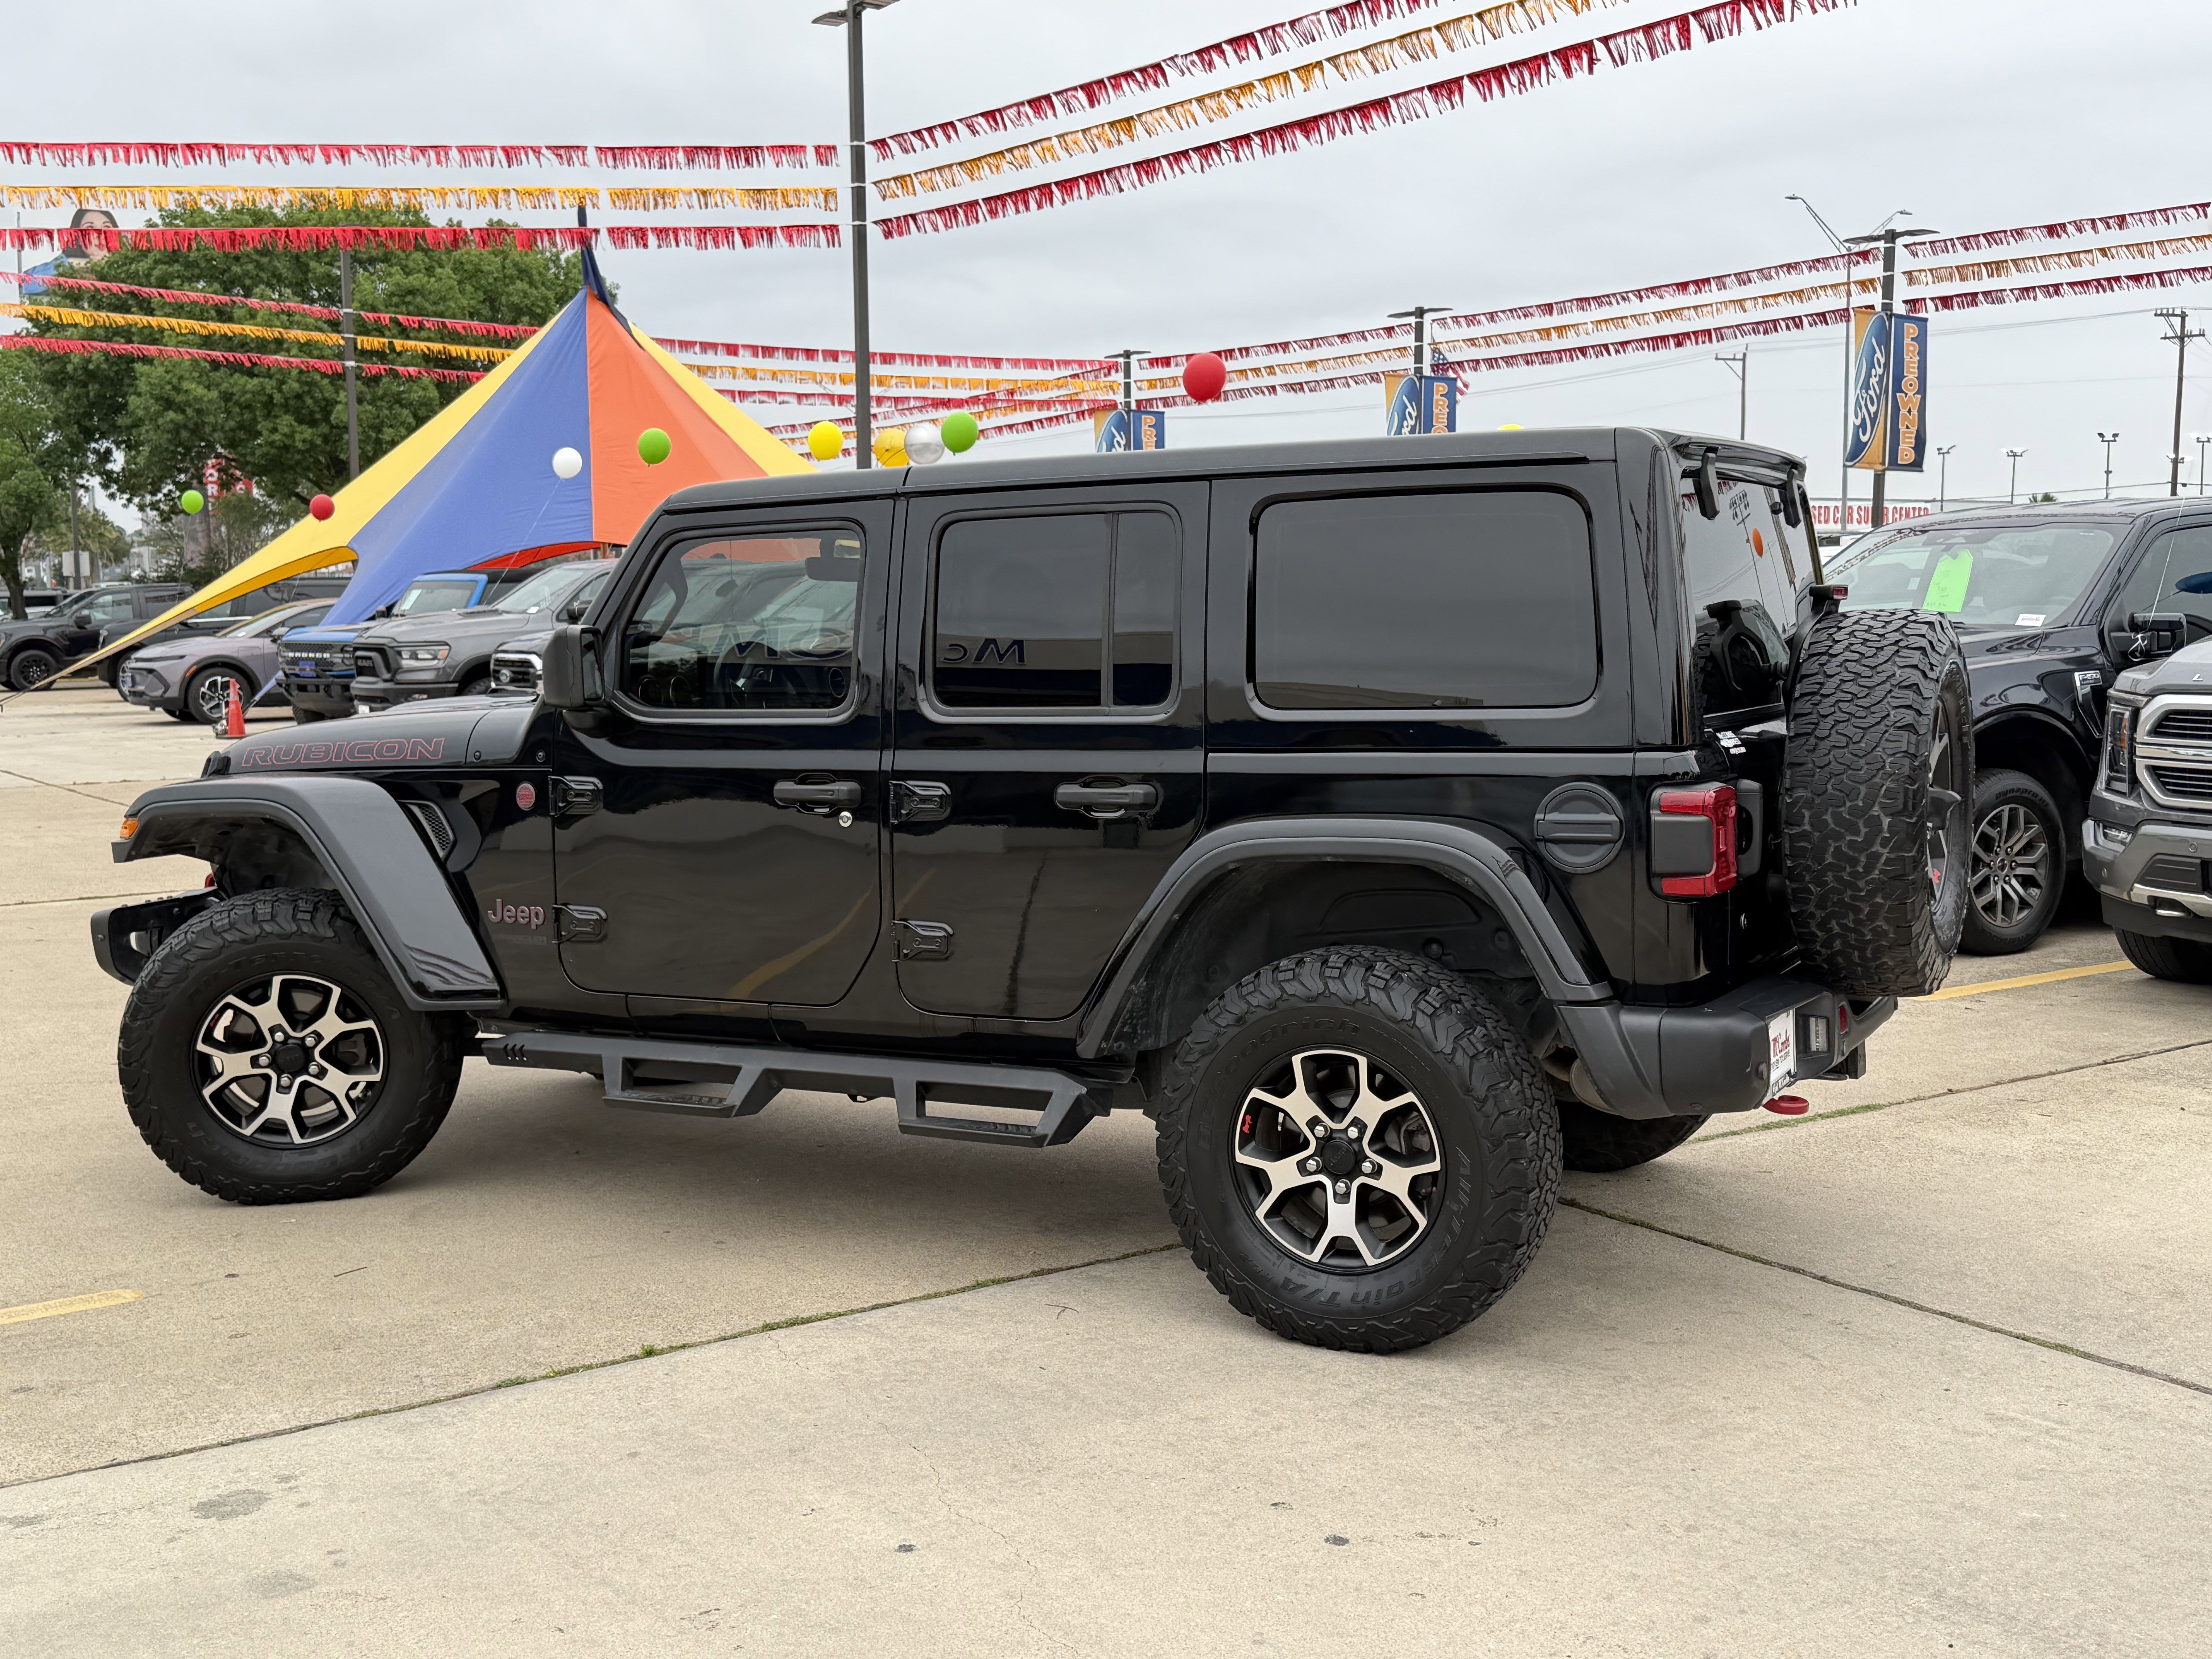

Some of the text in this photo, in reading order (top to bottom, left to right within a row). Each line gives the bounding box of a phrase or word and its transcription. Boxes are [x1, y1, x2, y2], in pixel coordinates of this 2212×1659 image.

[1853, 336, 1885, 442] Ford
[1896, 323, 1921, 464] PREOWNED
[1812, 505, 1831, 524] SED
[1833, 505, 1854, 525] CR
[1856, 506, 1889, 525] SUR
[242, 738, 445, 767] RUBICON
[488, 899, 546, 929] Jeep
